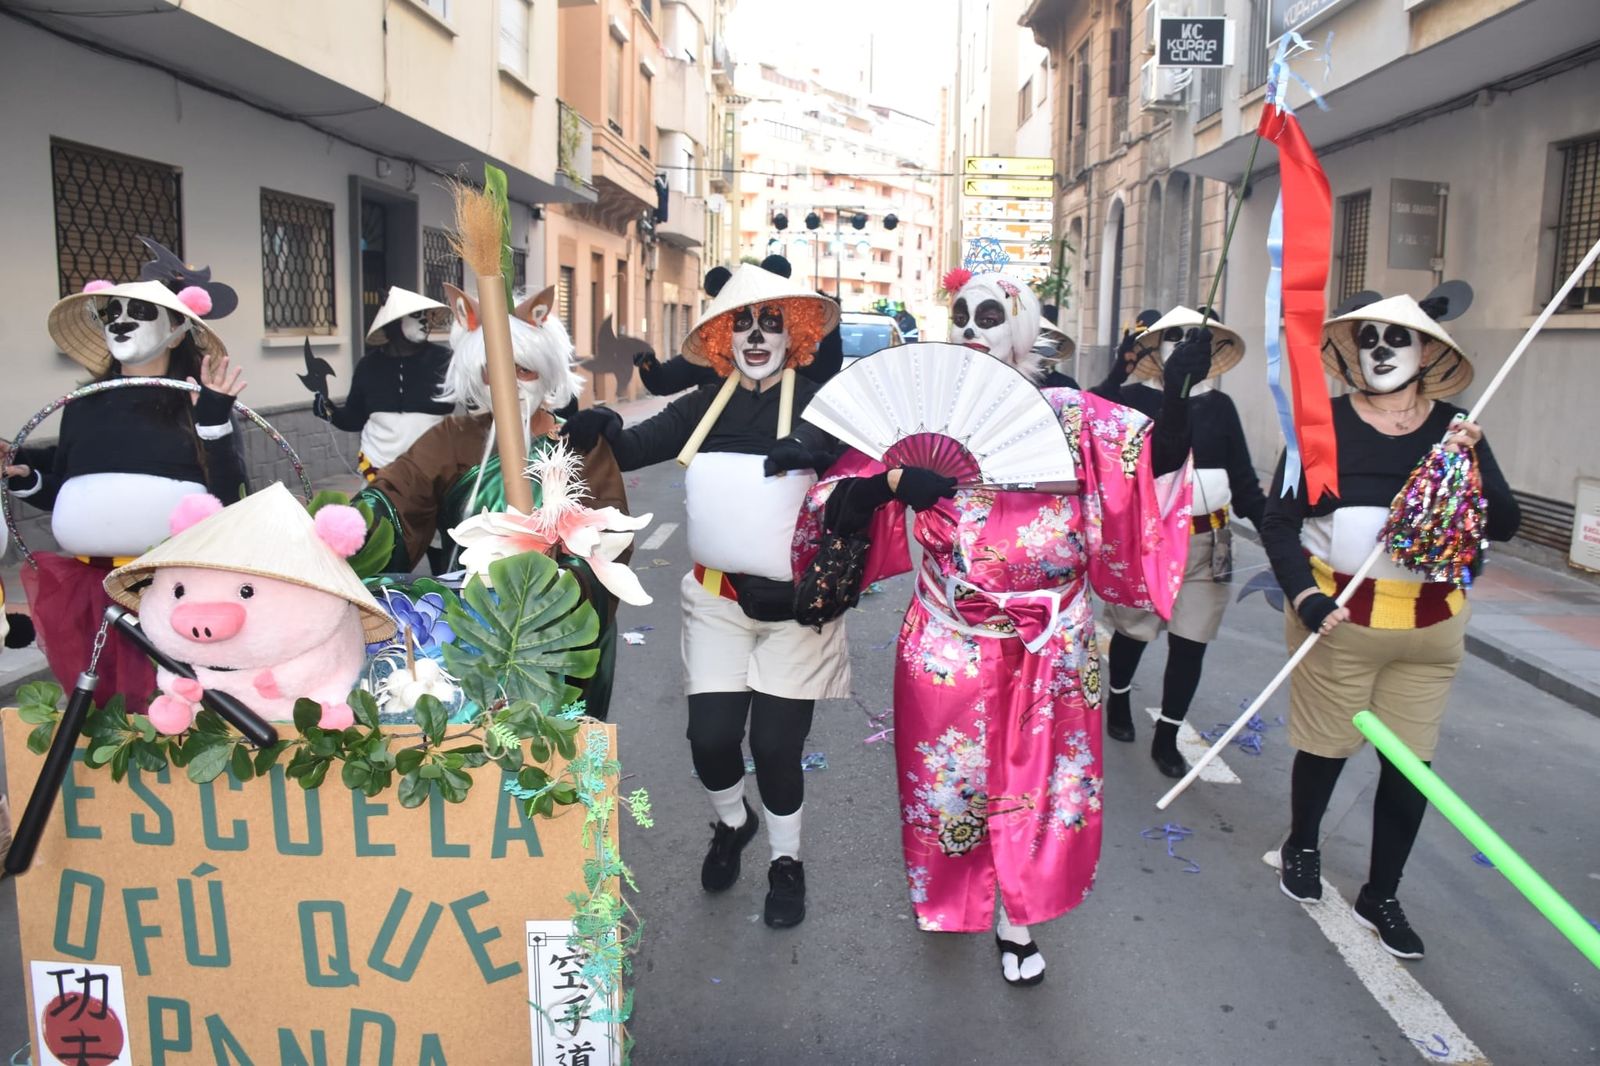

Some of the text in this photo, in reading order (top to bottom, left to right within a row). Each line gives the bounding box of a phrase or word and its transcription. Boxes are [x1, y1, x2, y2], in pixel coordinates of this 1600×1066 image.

[1171, 50, 1213, 62] CLINIC
[1181, 23, 1204, 39] KC
[62, 747, 544, 859] ESCUELA
[298, 887, 523, 988] QUE
